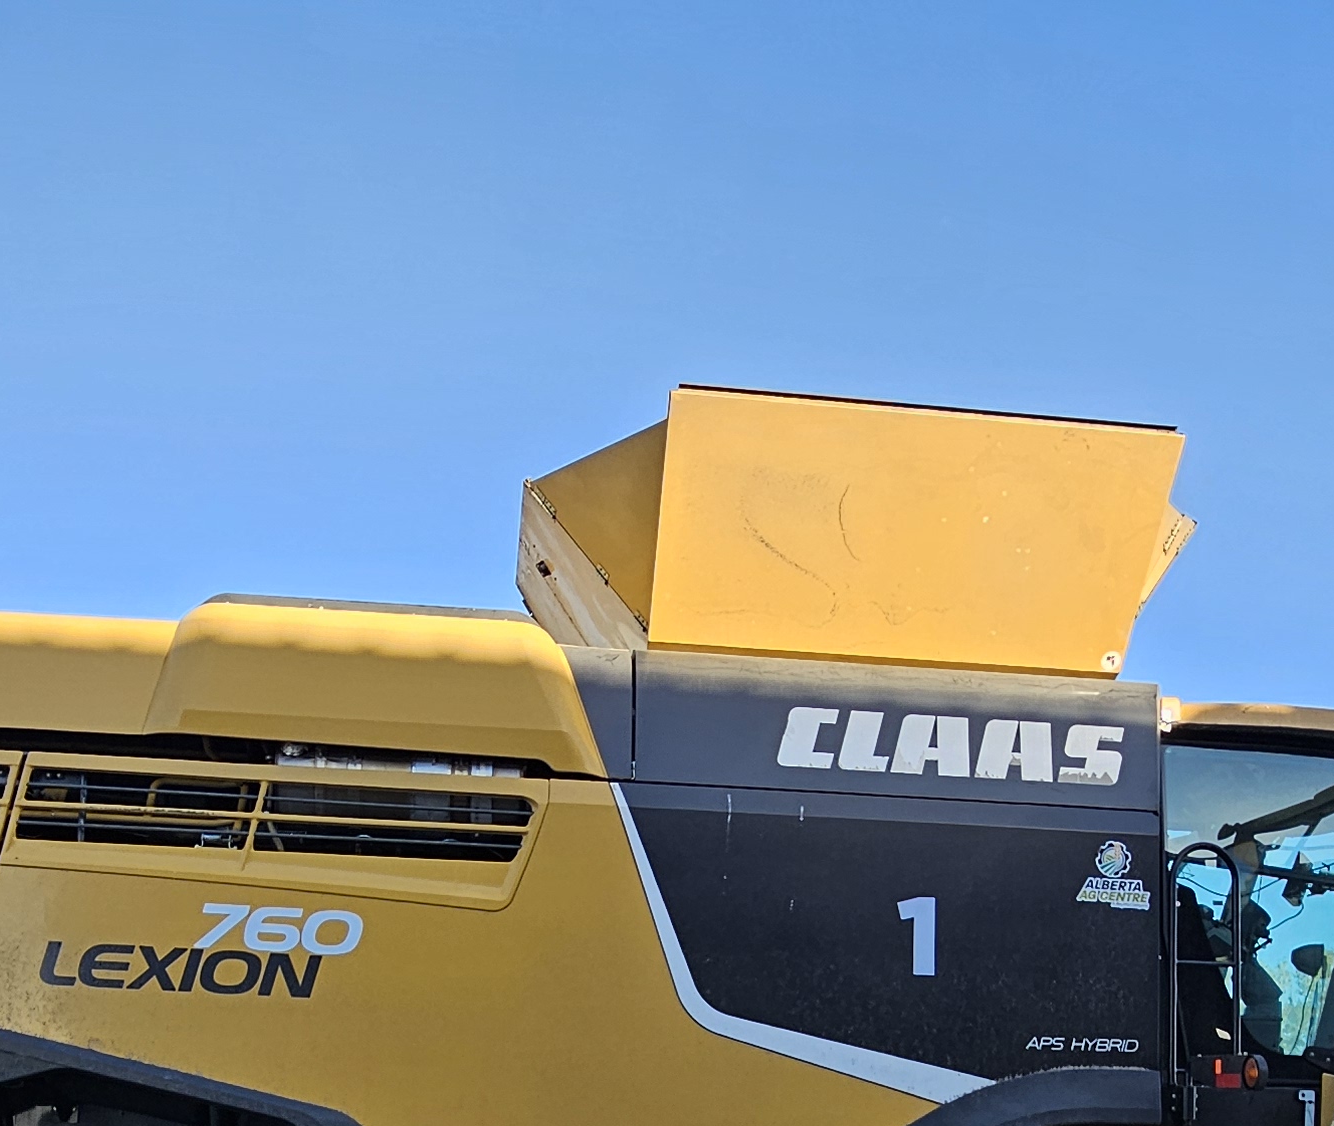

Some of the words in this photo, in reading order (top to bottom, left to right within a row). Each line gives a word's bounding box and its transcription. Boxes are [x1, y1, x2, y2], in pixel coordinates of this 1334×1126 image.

[777, 706, 1125, 787] CLAAS
[1079, 890, 1097, 900] AG
[1100, 891, 1149, 903] CENTRE
[1085, 879, 1142, 892] ALBERTA
[193, 902, 365, 956] 760
[896, 896, 937, 978] 1
[39, 940, 323, 999] LEXION
[1025, 1036, 1066, 1051] APS
[1070, 1037, 1140, 1053] HYBRID
